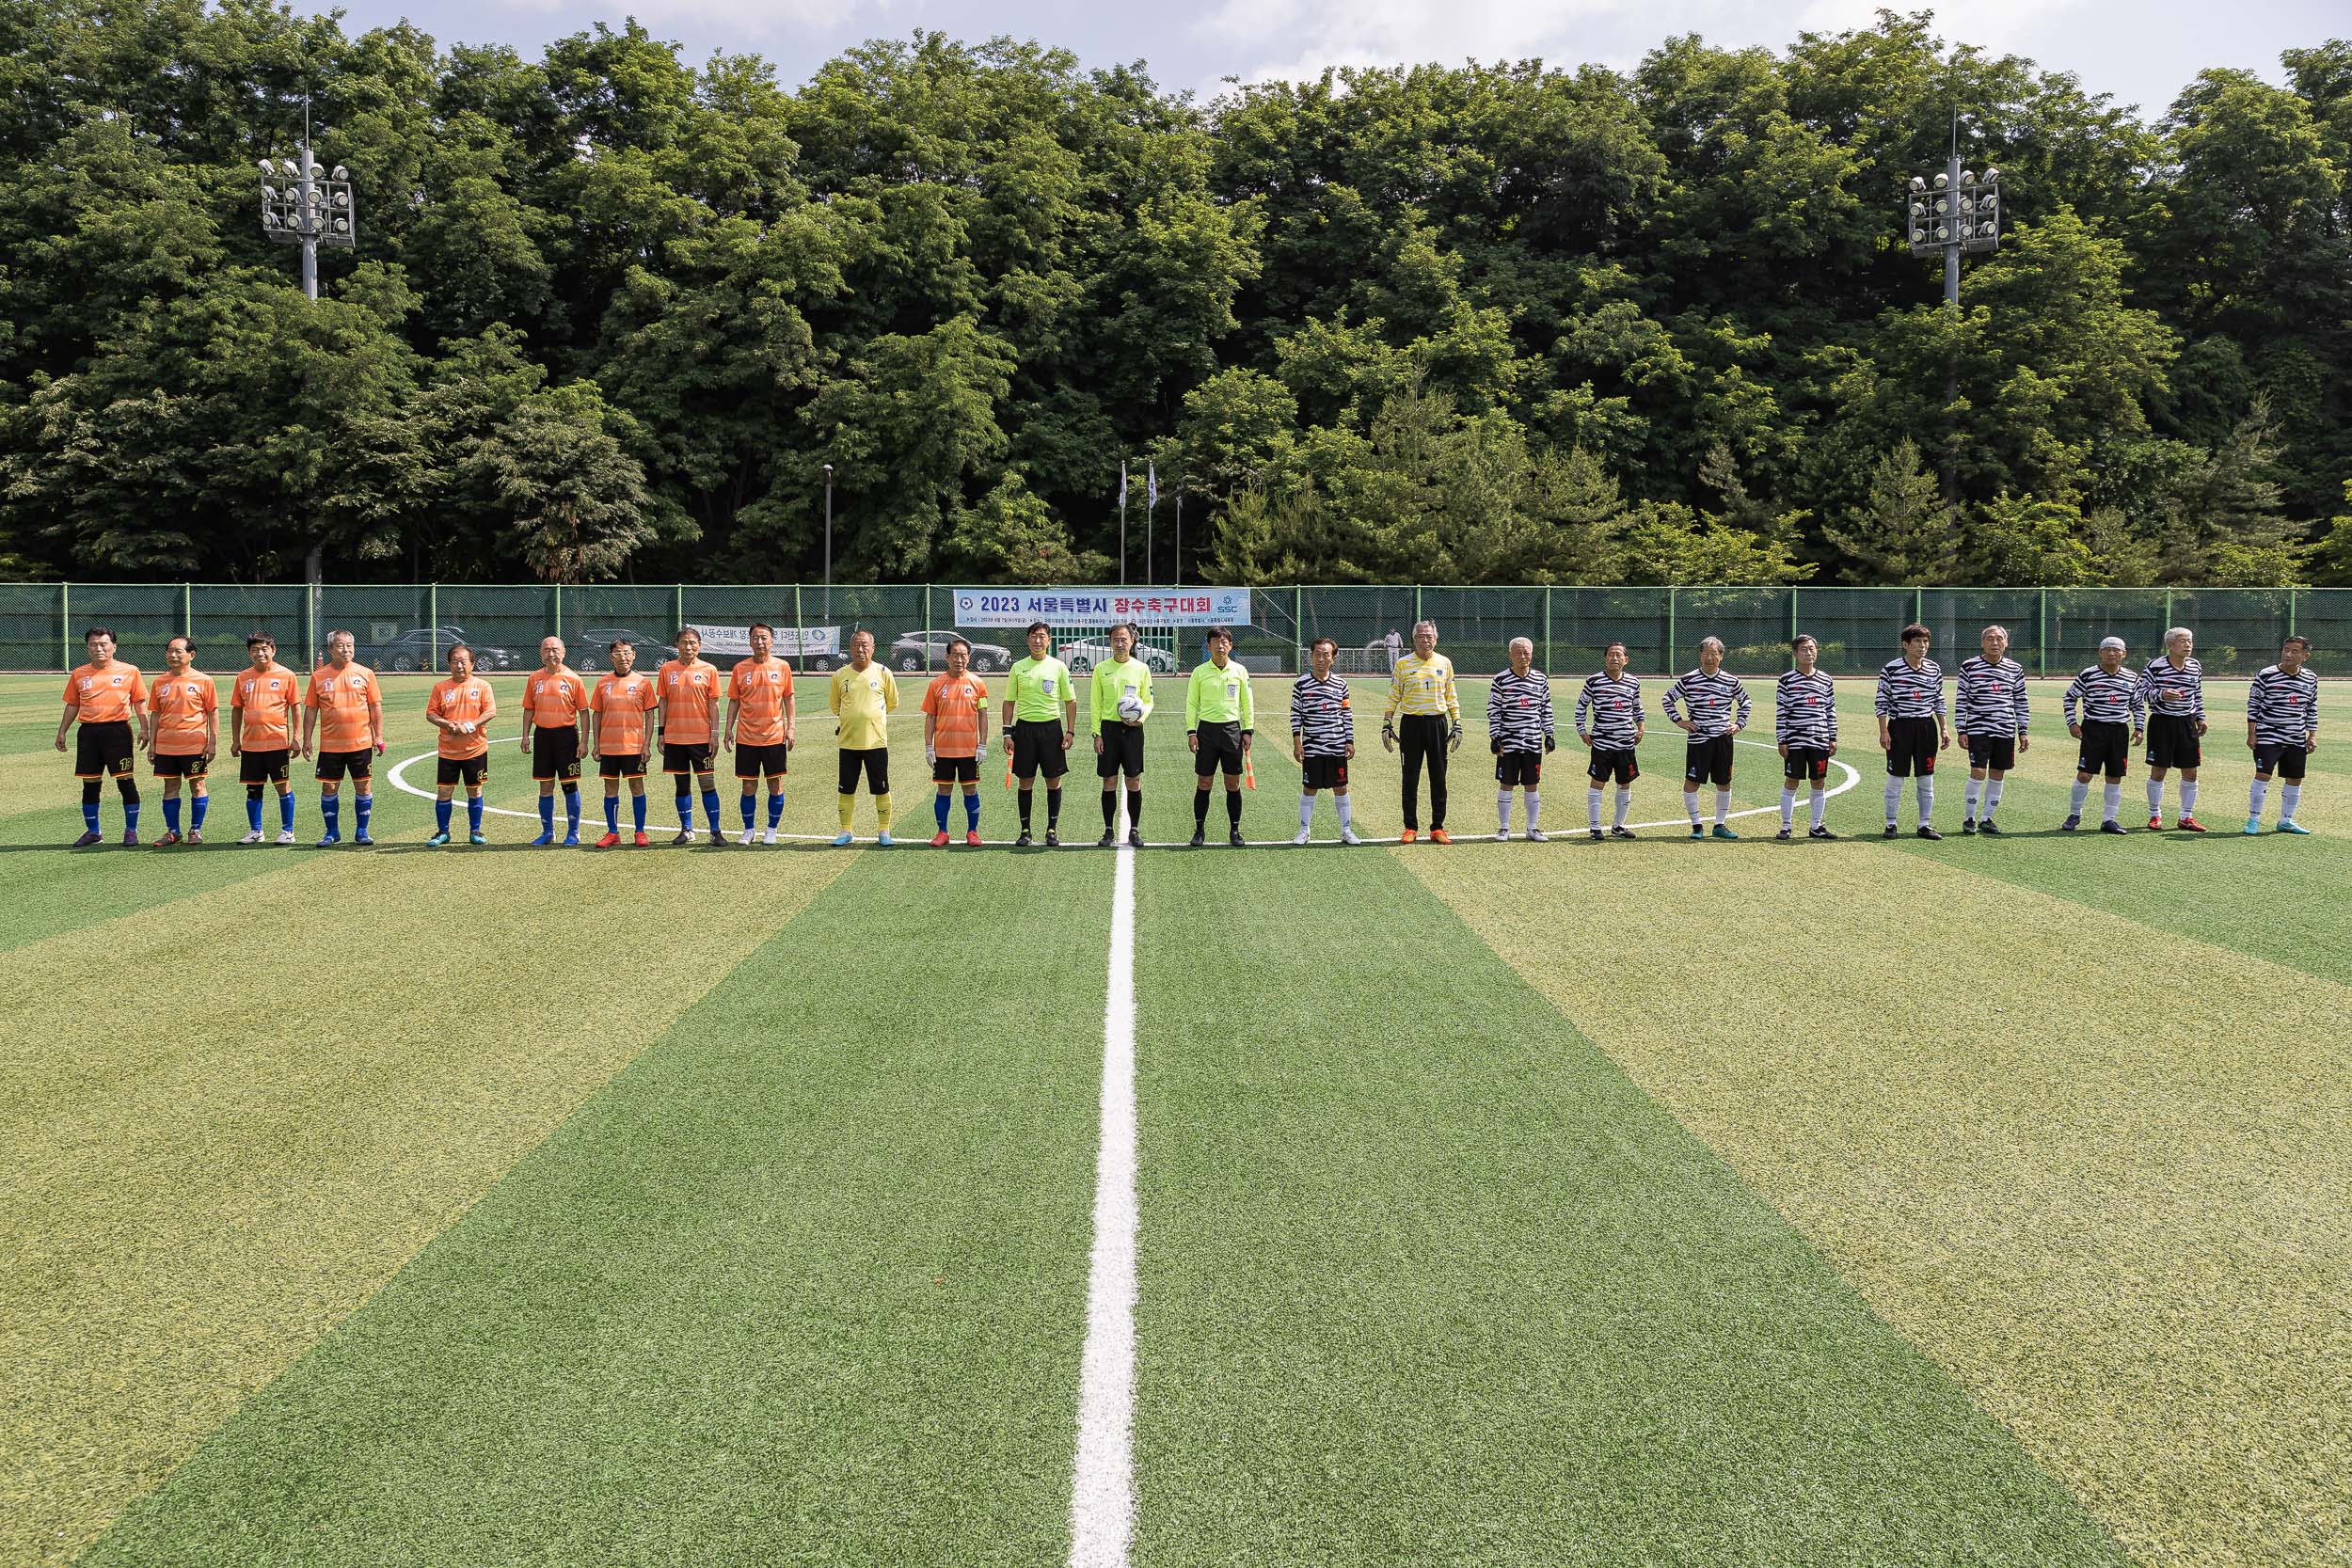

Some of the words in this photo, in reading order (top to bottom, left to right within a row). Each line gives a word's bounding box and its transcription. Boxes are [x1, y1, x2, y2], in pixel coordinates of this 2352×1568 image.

[981, 596, 1020, 611] 2023
[1027, 597, 1107, 613] 서울특별시
[1115, 596, 1211, 613] 장수축구대회
[83, 681, 92, 691] 13
[670, 675, 677, 686] 12
[1425, 681, 1430, 691] 1
[446, 692, 455, 704] 99
